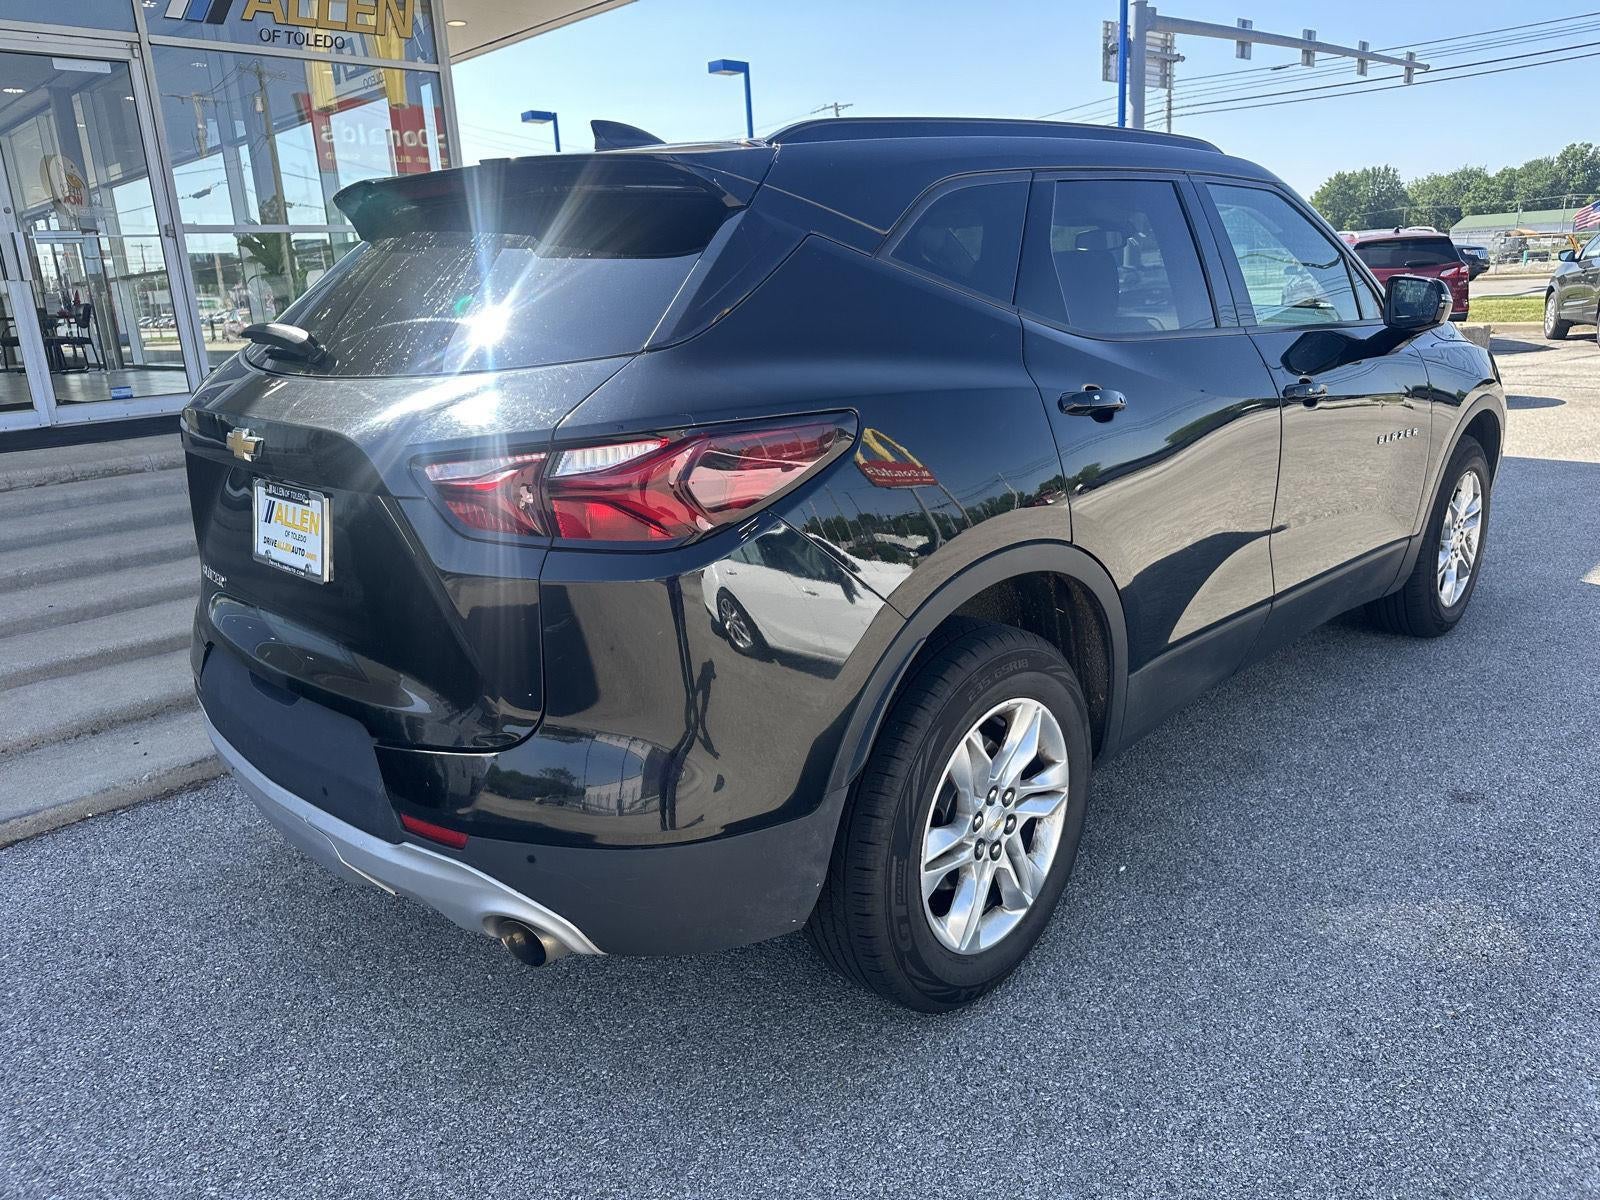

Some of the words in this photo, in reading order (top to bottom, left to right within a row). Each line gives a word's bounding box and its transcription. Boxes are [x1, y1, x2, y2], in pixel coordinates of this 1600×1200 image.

[241, 0, 414, 38] ALLEN
[259, 28, 281, 43] OF
[286, 31, 345, 49] TOLEDO
[1376, 427, 1419, 445] BLAZER
[272, 484, 285, 498] ALLEN
[290, 490, 306, 501] TOLEDO
[274, 502, 321, 536] ALLEN
[290, 531, 307, 543] TOLEDO
